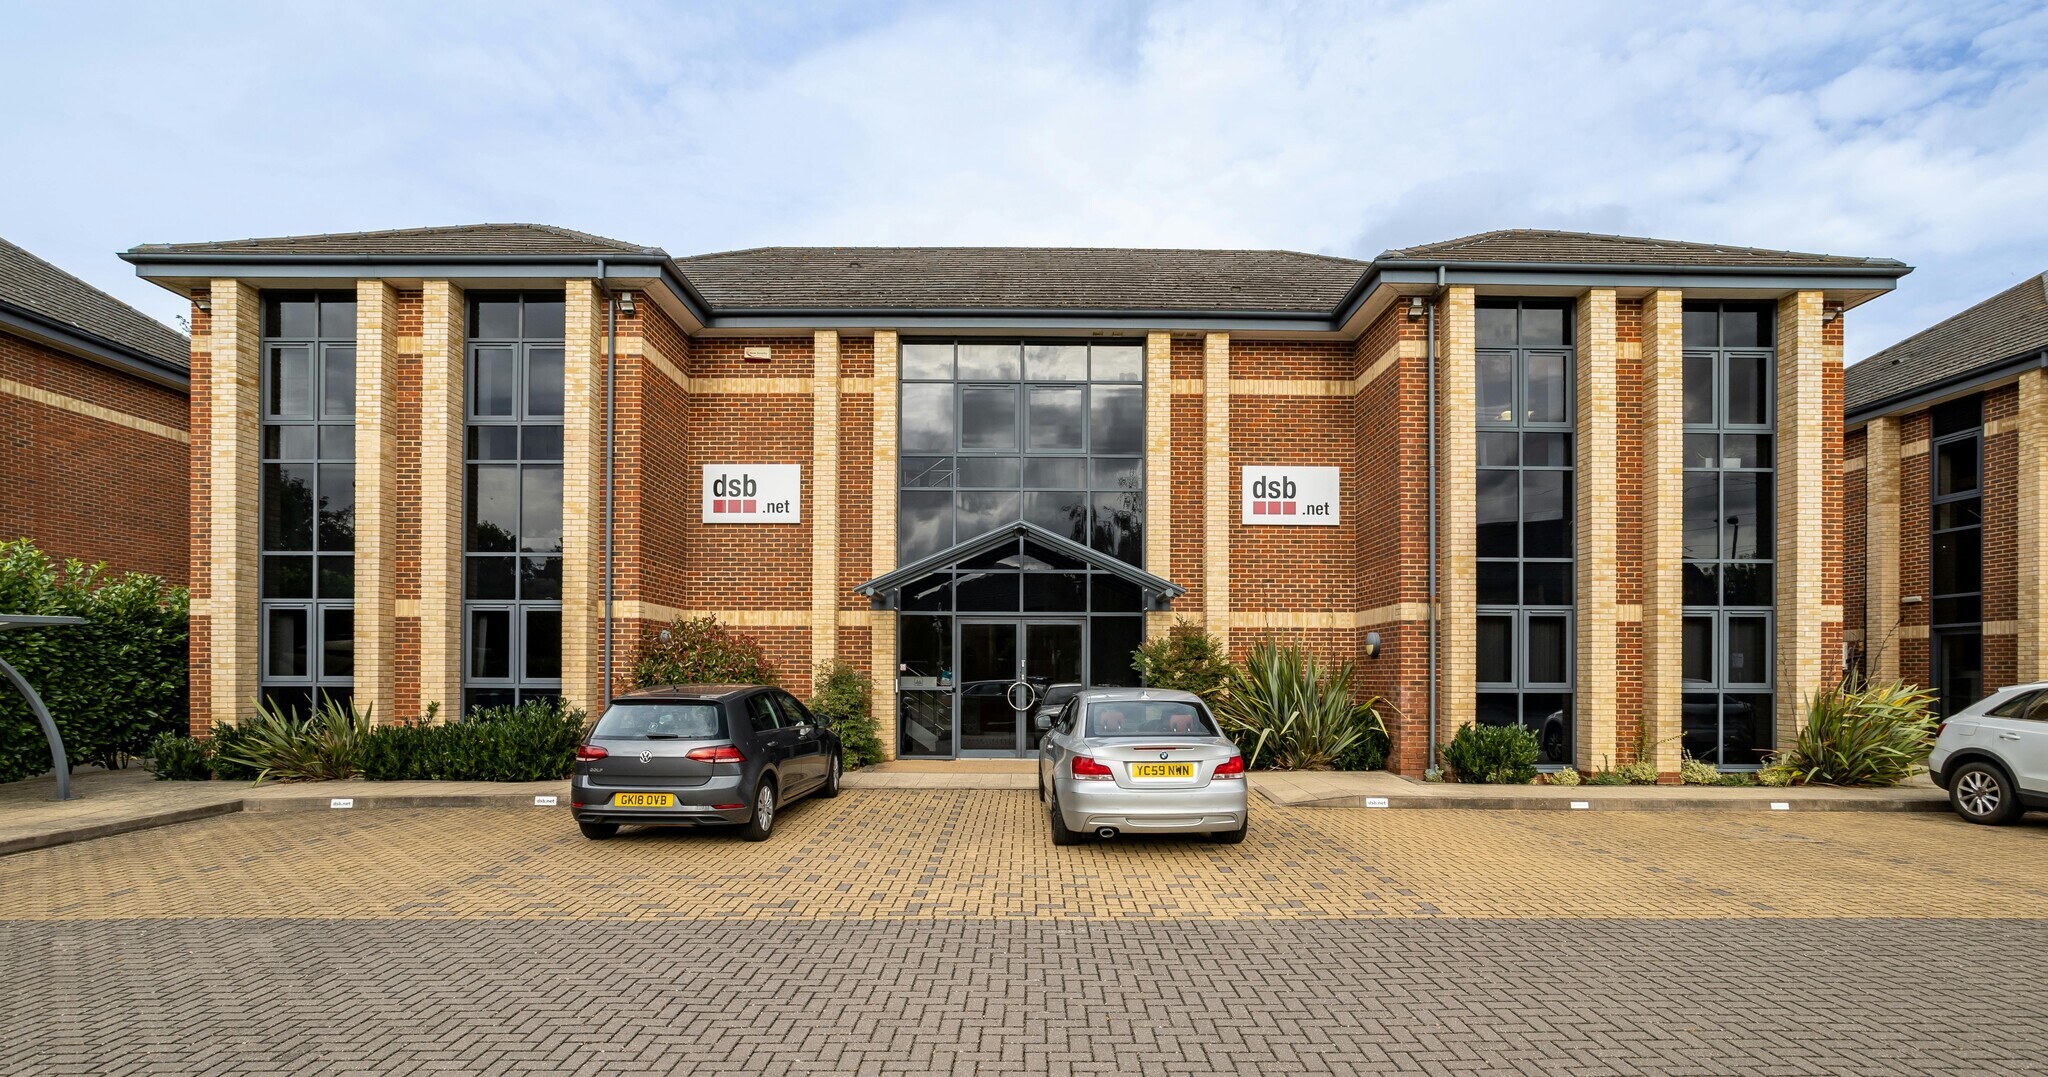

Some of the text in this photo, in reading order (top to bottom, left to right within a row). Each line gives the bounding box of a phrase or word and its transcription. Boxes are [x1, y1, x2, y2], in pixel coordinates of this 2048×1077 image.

[713, 474, 757, 497] dsb
[1253, 476, 1297, 499] dsb
[762, 500, 790, 513] .net
[1302, 502, 1330, 515] .net
[1137, 765, 1189, 776] YC59 NWN
[621, 795, 667, 805] GK18 OVB
